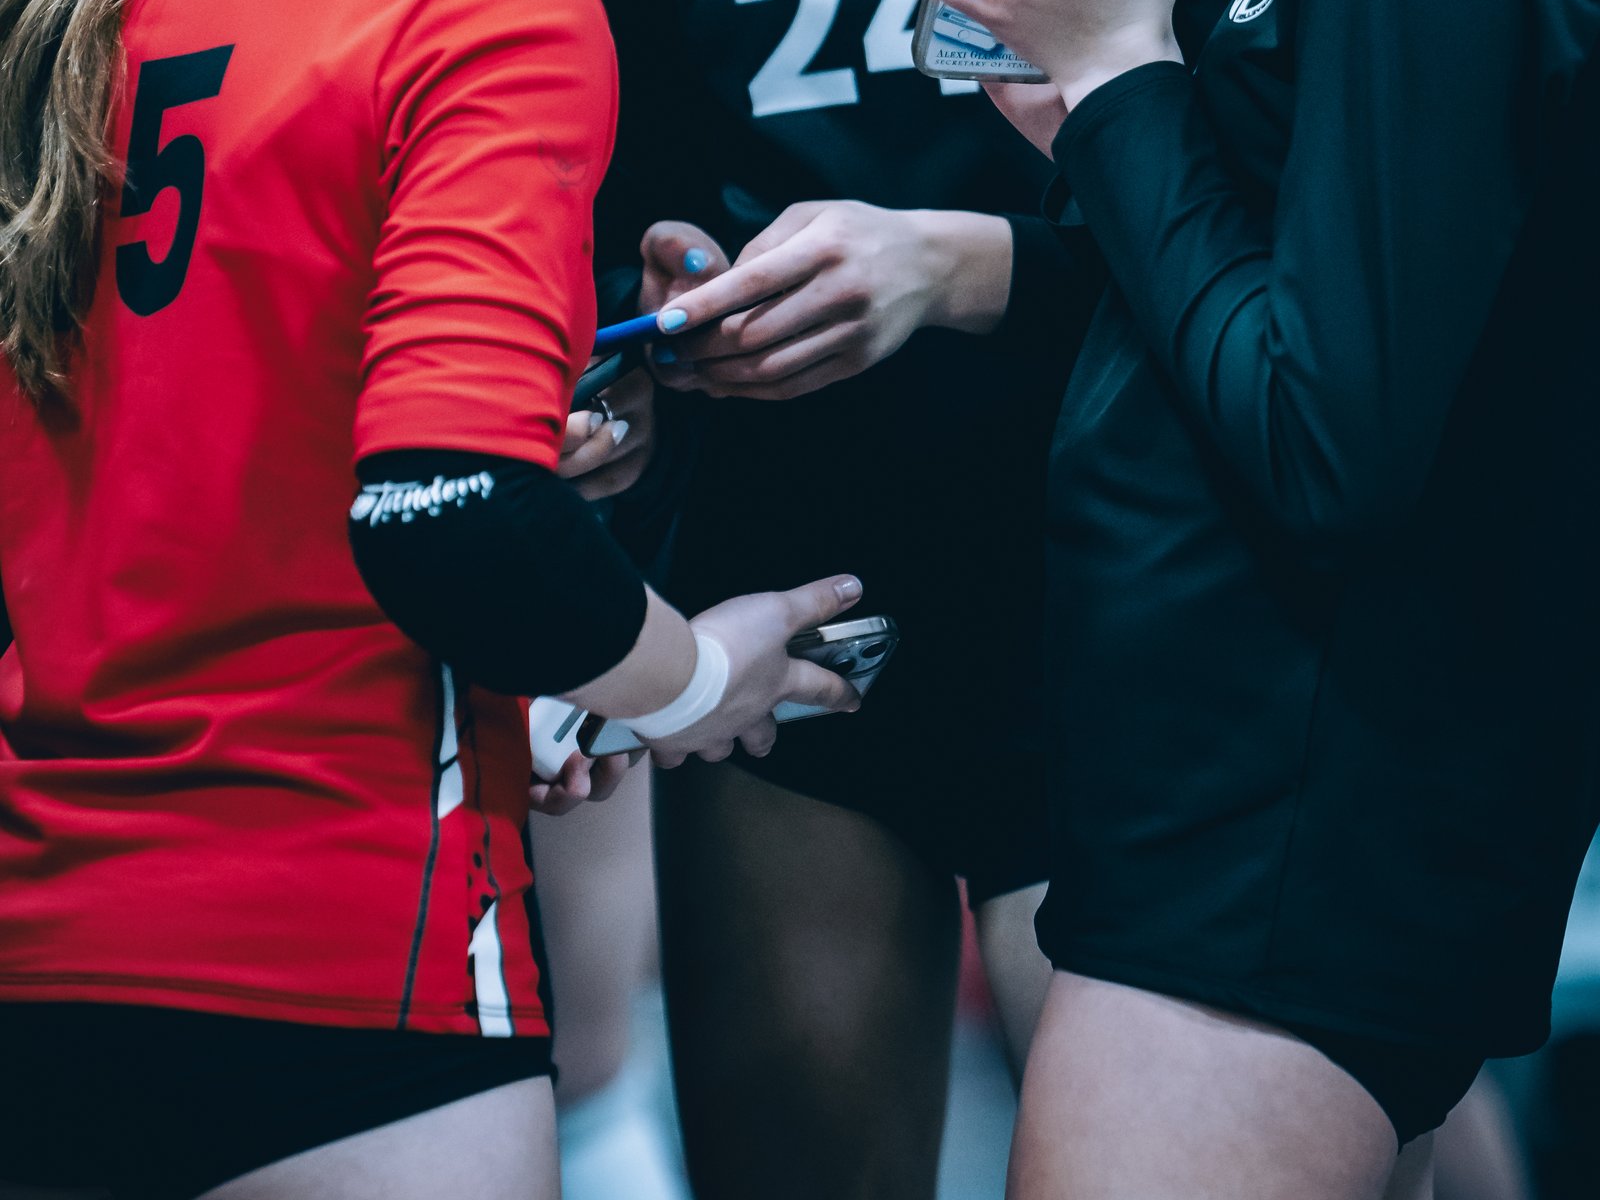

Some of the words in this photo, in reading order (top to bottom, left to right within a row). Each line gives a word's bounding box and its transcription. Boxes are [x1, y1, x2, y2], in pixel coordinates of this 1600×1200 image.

[936, 49, 967, 59] ALEXI
[935, 59, 985, 67] SECRETARY
[115, 43, 236, 318] 5
